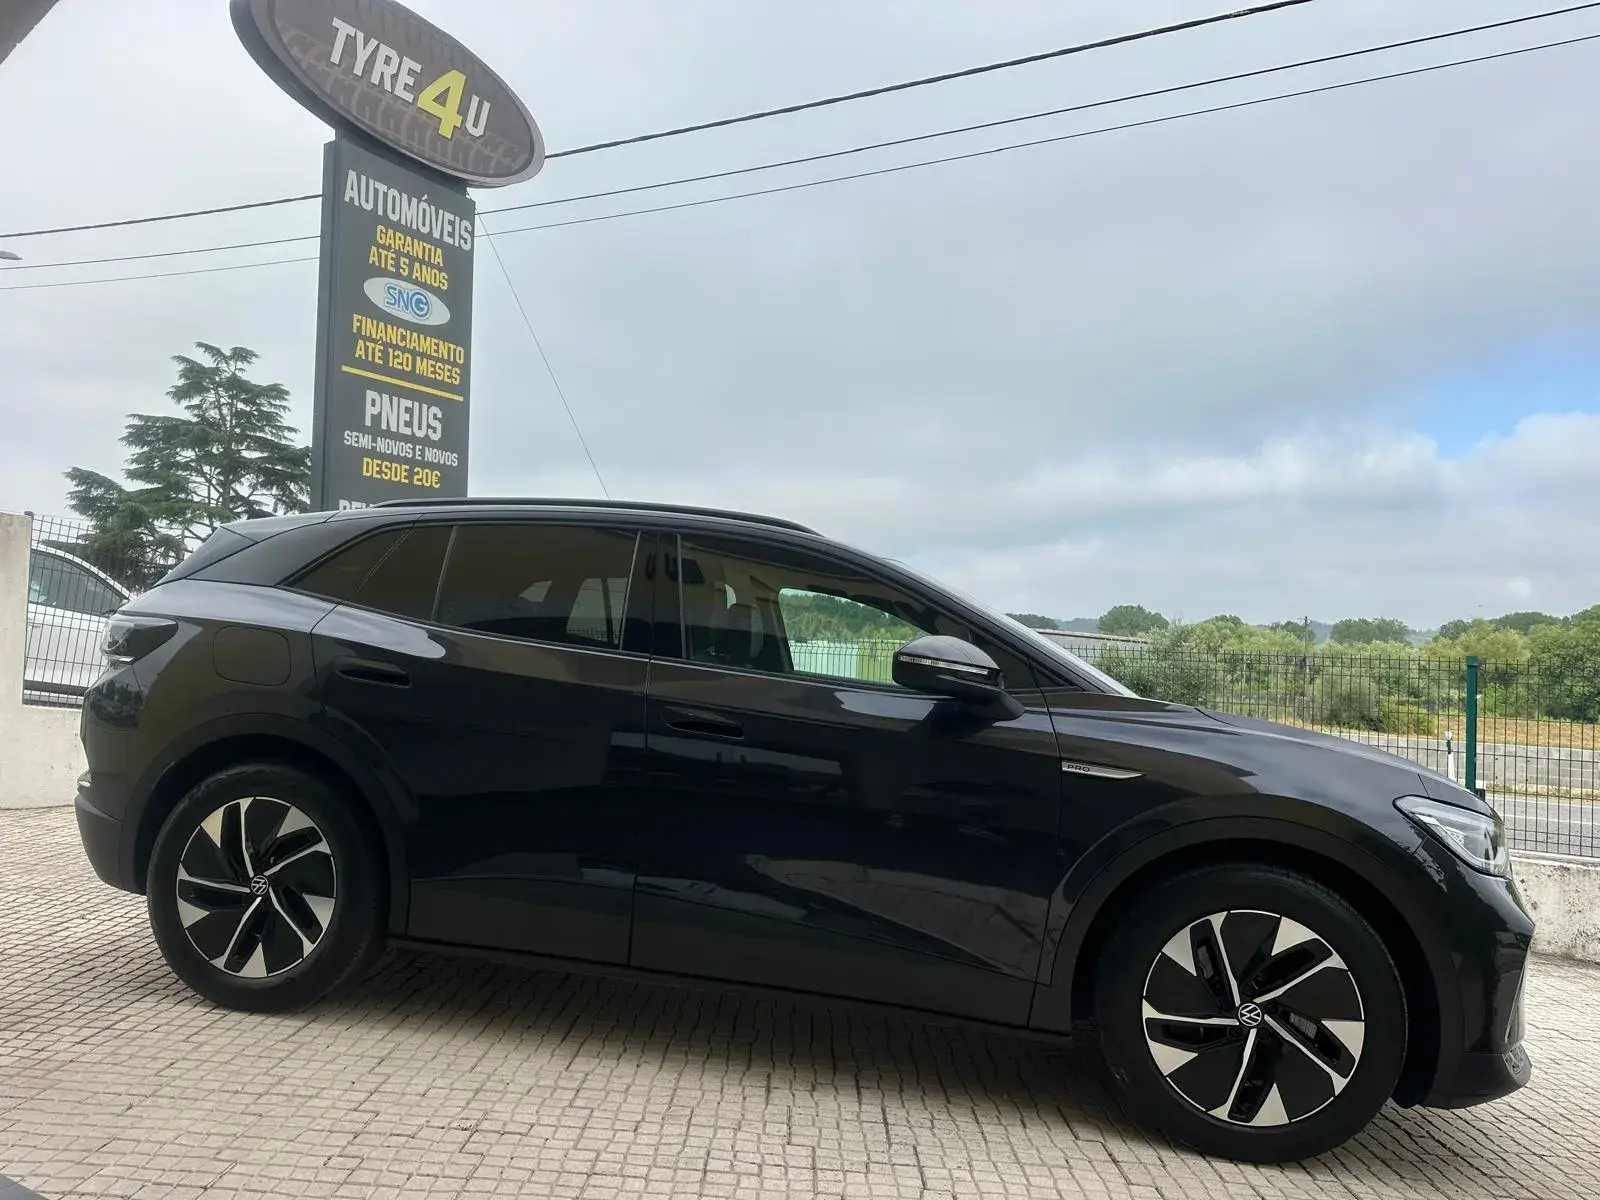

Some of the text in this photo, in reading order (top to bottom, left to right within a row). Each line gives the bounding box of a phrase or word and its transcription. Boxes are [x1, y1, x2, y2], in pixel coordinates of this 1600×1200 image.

[344, 169, 472, 251] AUTOMÓVEIS
[376, 224, 443, 267] GARANTIA
[368, 245, 448, 291] ATÉ 5 ANOS
[384, 282, 433, 321] SNG
[352, 313, 465, 365] FINANCIAMENTO
[355, 340, 460, 385] ATÉ 120 MESES
[365, 389, 443, 441] PNEUS
[344, 430, 459, 467] SEMI-NOVOS E NOVOS
[362, 457, 441, 489] DESDE 20€
[1067, 763, 1090, 773] PRO
